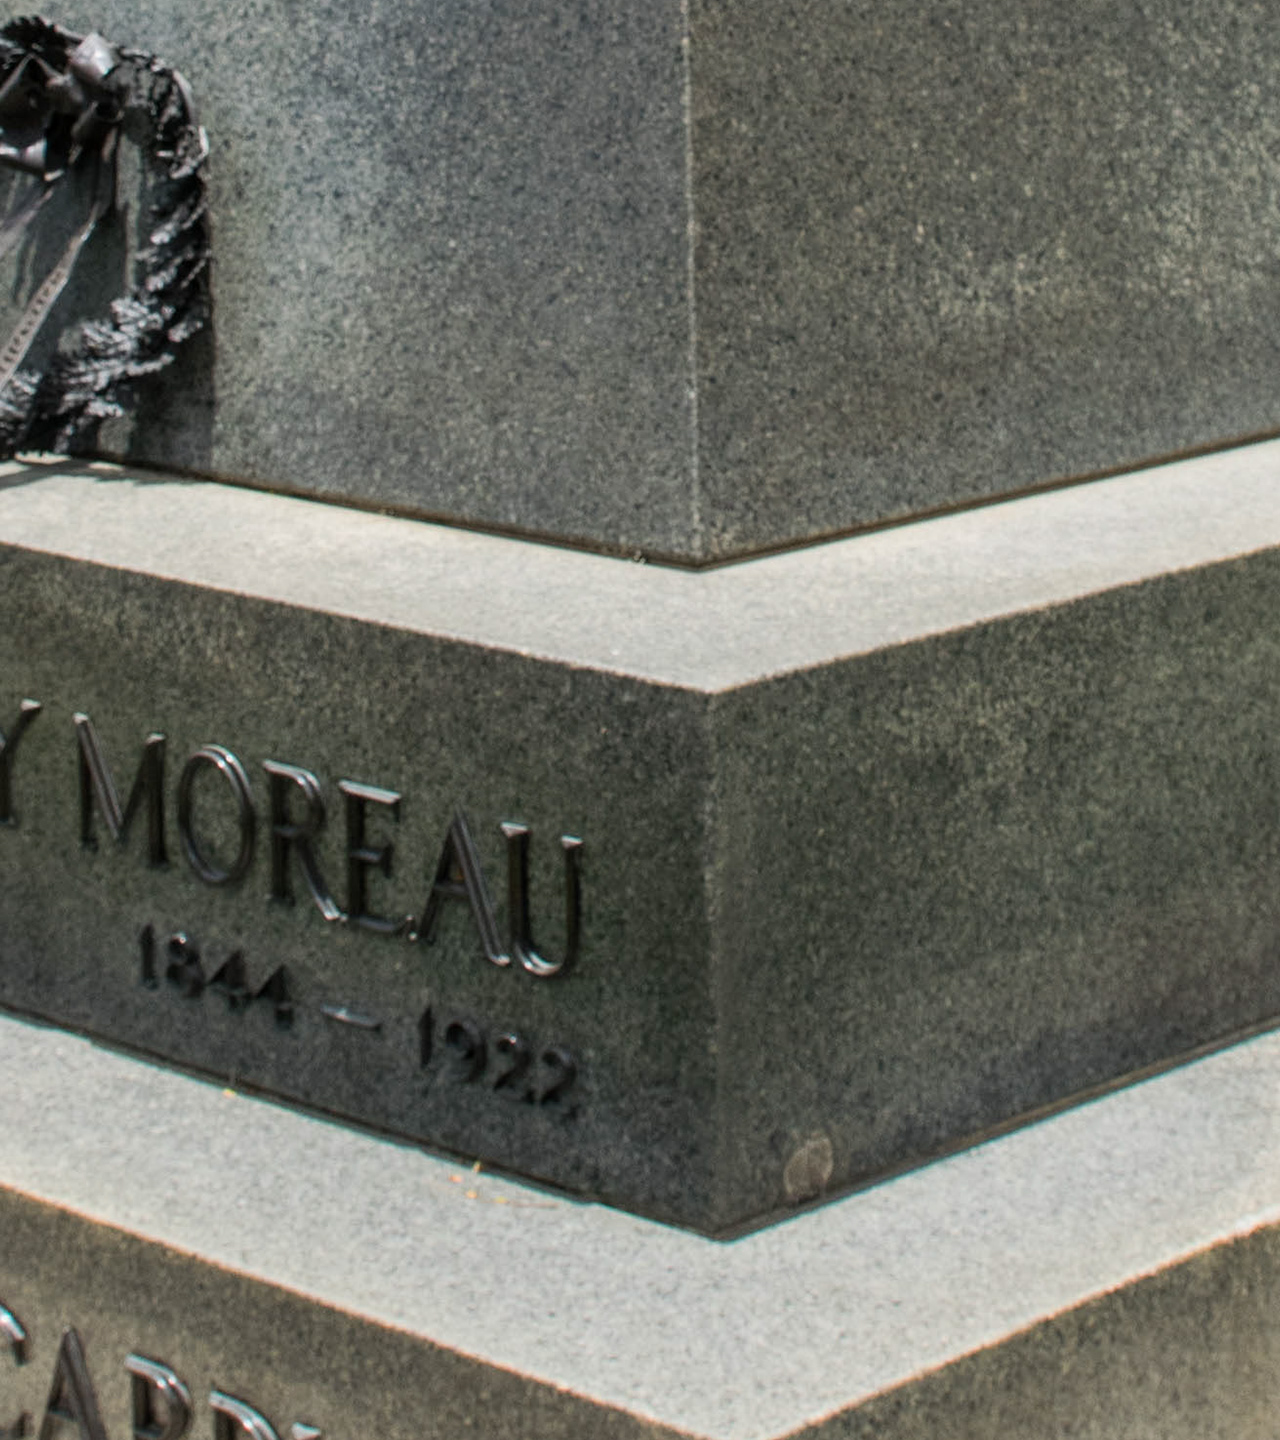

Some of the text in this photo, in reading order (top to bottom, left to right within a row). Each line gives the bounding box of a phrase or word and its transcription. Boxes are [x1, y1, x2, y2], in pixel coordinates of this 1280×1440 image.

[74, 712, 583, 978] MOREAU
[141, 923, 294, 1030] 1844
[419, 1007, 579, 1120] 1922
